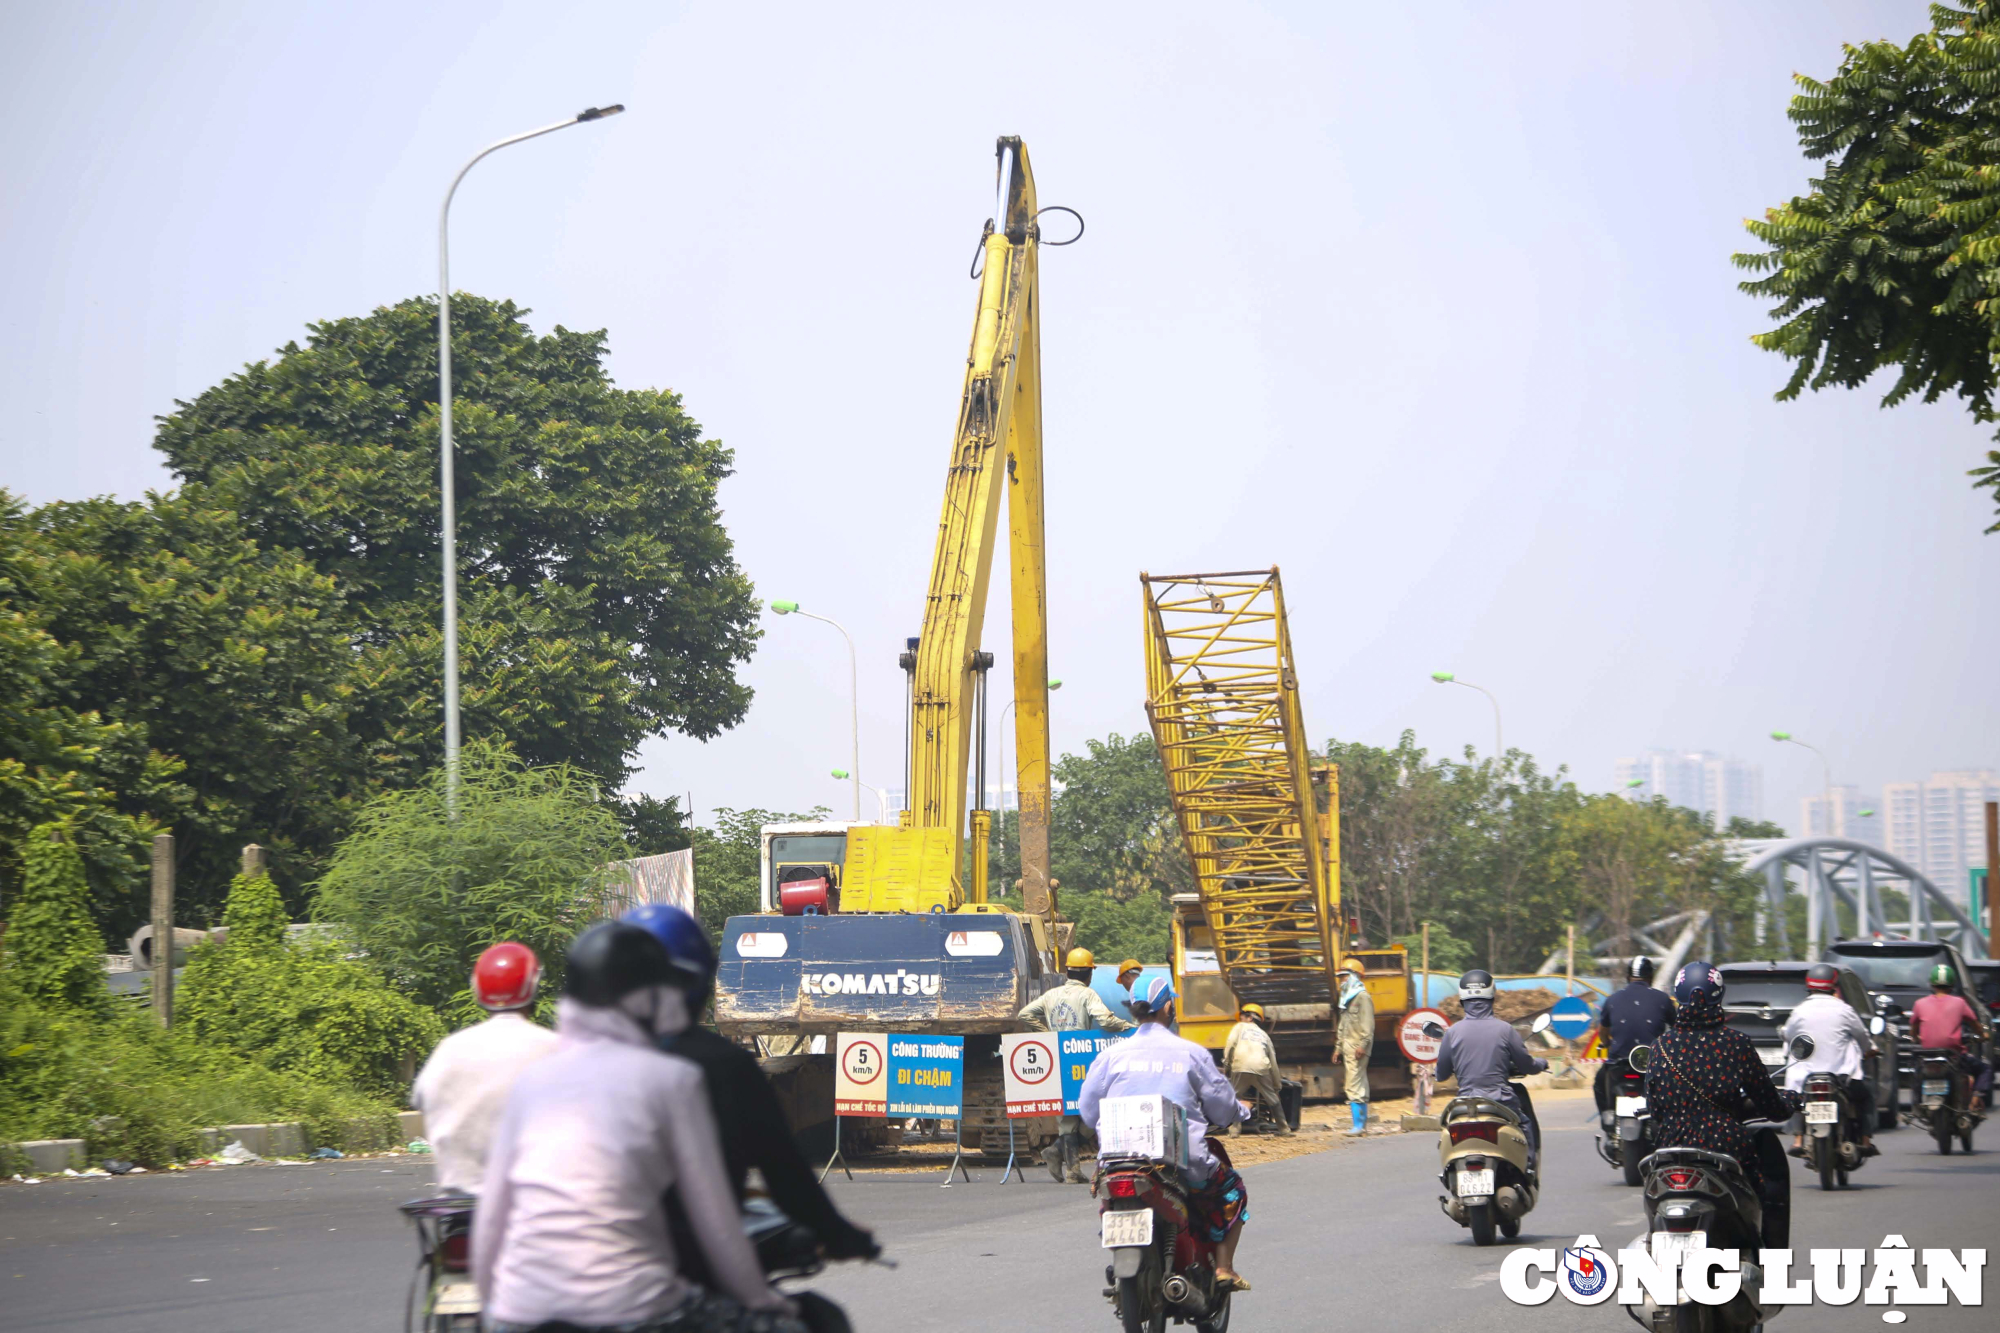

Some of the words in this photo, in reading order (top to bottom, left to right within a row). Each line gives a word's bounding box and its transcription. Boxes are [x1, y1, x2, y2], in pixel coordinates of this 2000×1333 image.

[802, 969, 940, 995] KOMATSU
[892, 1041, 919, 1057] CÔNG
[920, 1042, 960, 1059] TRƯỜNG
[1063, 1037, 1093, 1054] CÔNG
[858, 1049, 868, 1064] 5
[1027, 1048, 1037, 1064] 5
[852, 1066, 873, 1075] km/h
[897, 1069, 911, 1085] ĐI
[914, 1067, 952, 1089] CHẬM
[1022, 1066, 1044, 1075] km/h
[1071, 1064, 1087, 1081] ĐI
[836, 1102, 850, 1113] HẠN
[1007, 1104, 1022, 1115] HẠN
[1023, 1102, 1037, 1113] CHẾ
[1037, 1101, 1051, 1112] TỐC
[1051, 1101, 1062, 1113] ĐỘ
